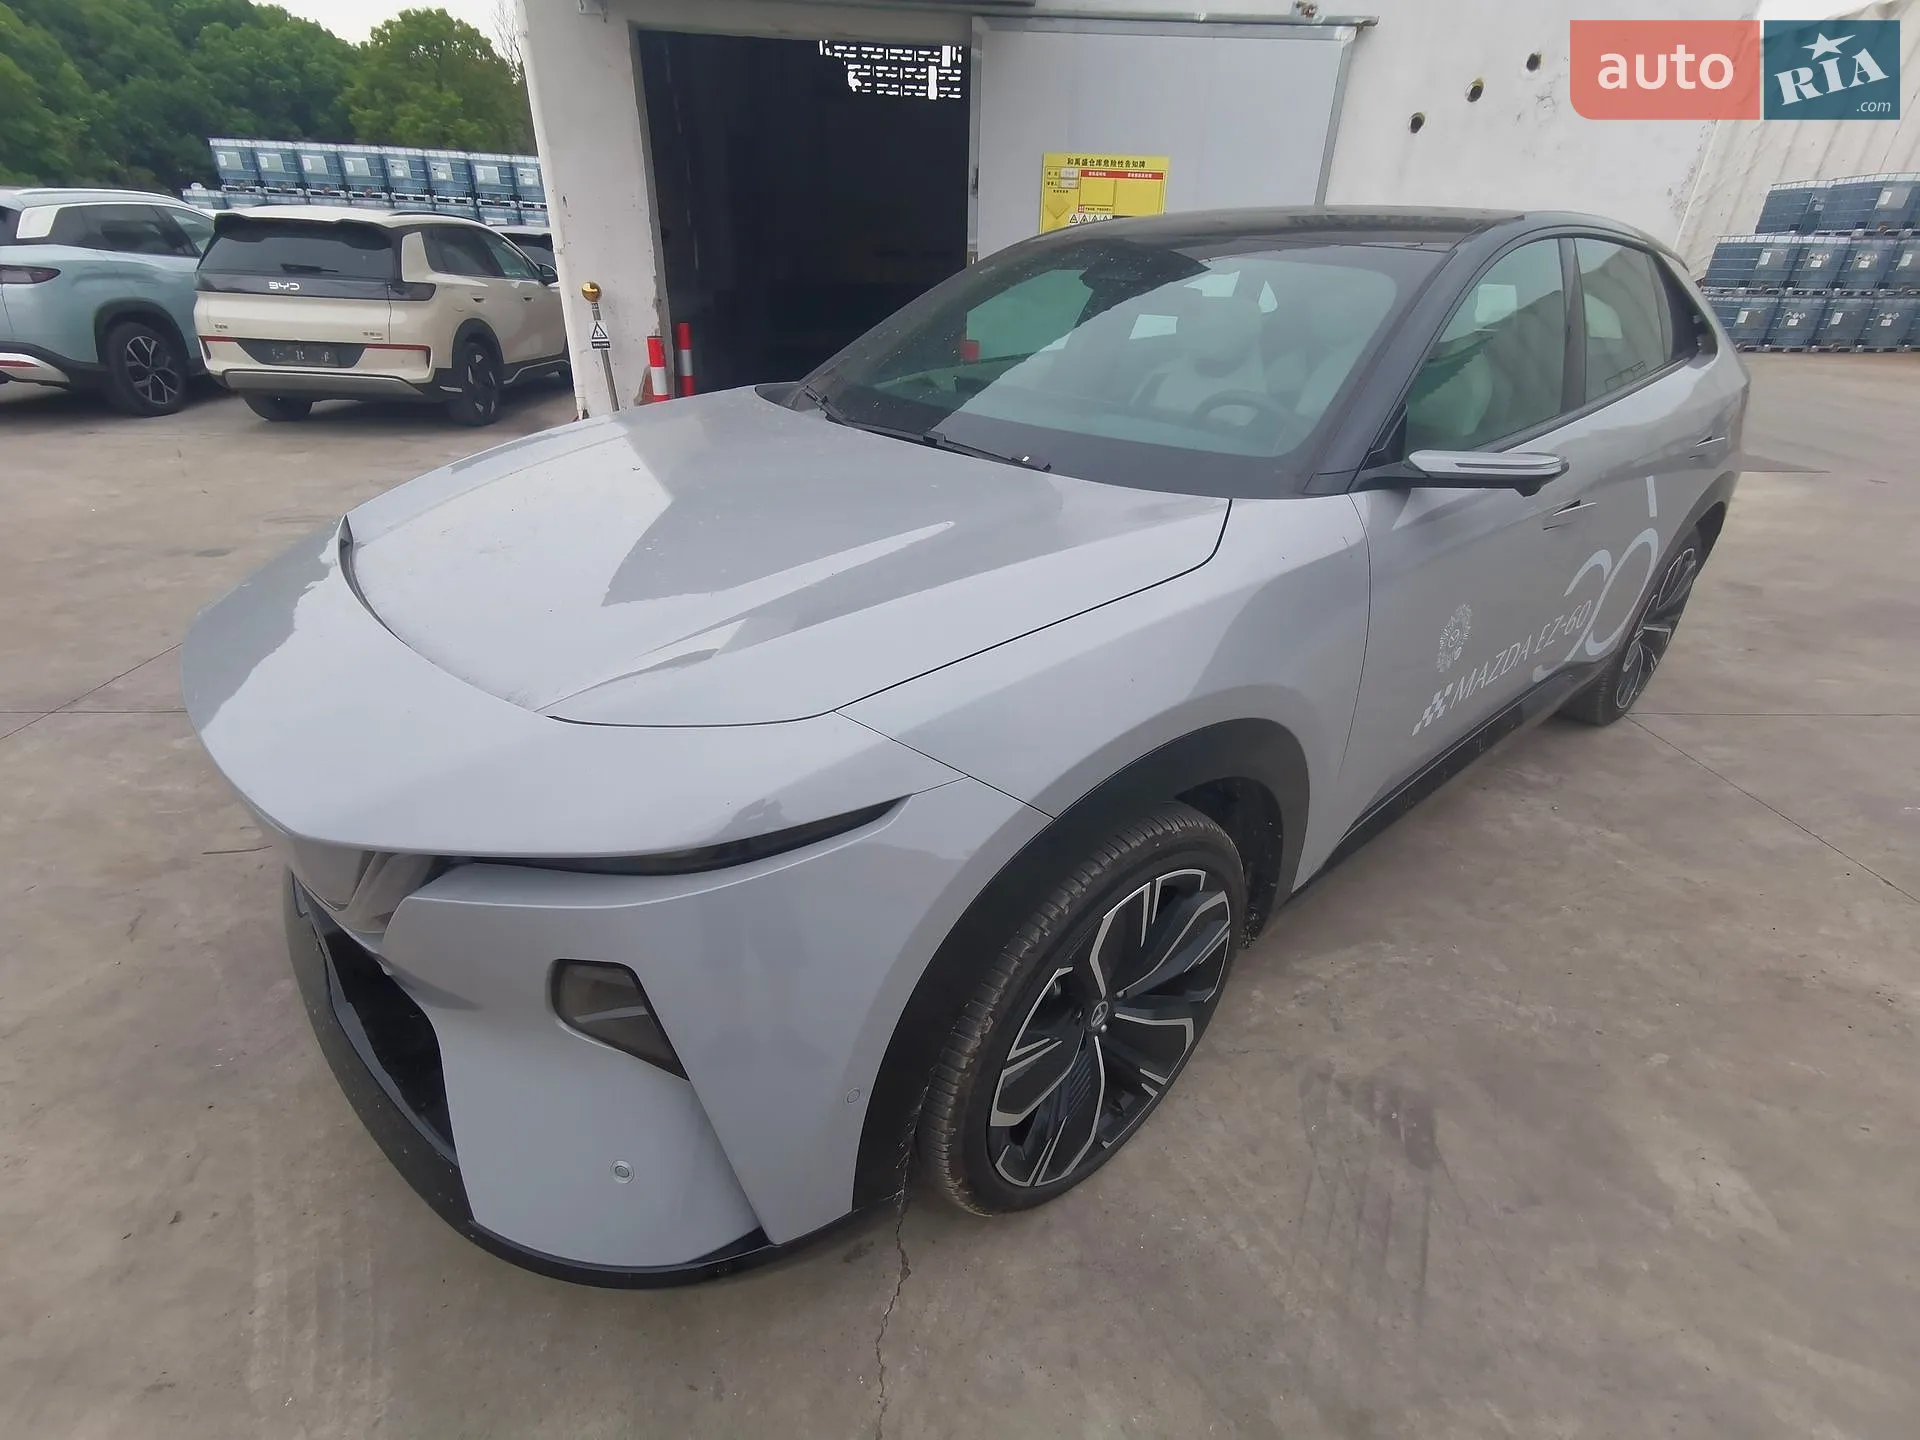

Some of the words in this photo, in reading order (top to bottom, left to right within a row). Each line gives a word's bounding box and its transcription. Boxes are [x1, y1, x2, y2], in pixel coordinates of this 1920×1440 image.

[268, 281, 301, 291] BYD
[1450, 634, 1531, 709] MAZDA
[1533, 599, 1592, 654] EZ-60
